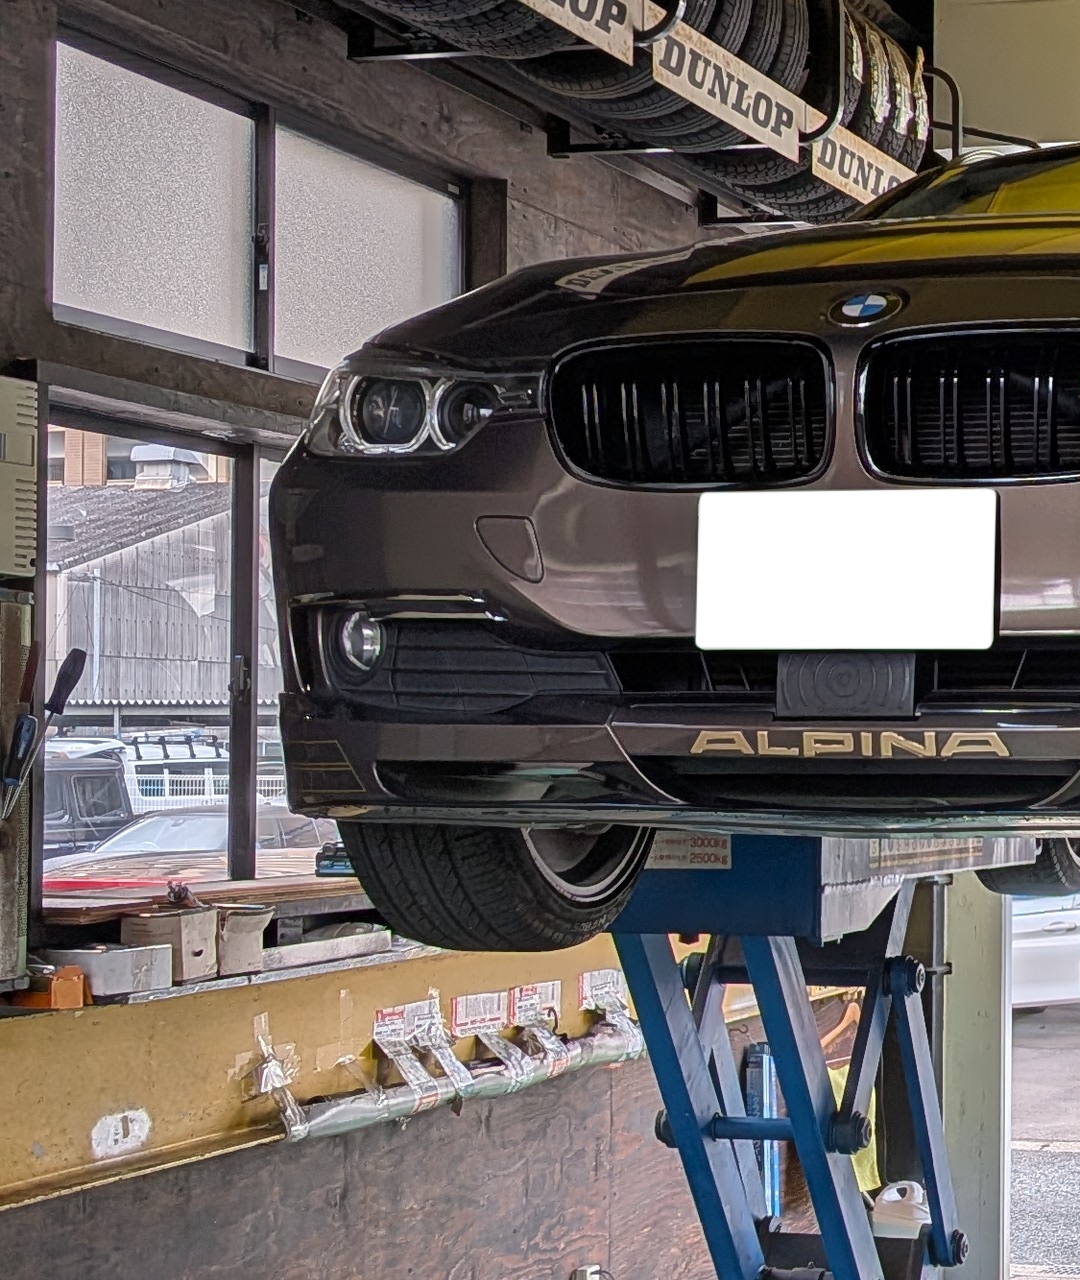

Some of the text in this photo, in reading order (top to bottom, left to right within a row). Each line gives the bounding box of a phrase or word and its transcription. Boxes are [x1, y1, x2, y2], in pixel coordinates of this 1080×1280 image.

[659, 35, 794, 137] DUNLOP
[817, 137, 902, 198] DUNL
[690, 730, 1010, 757] ALPINA
